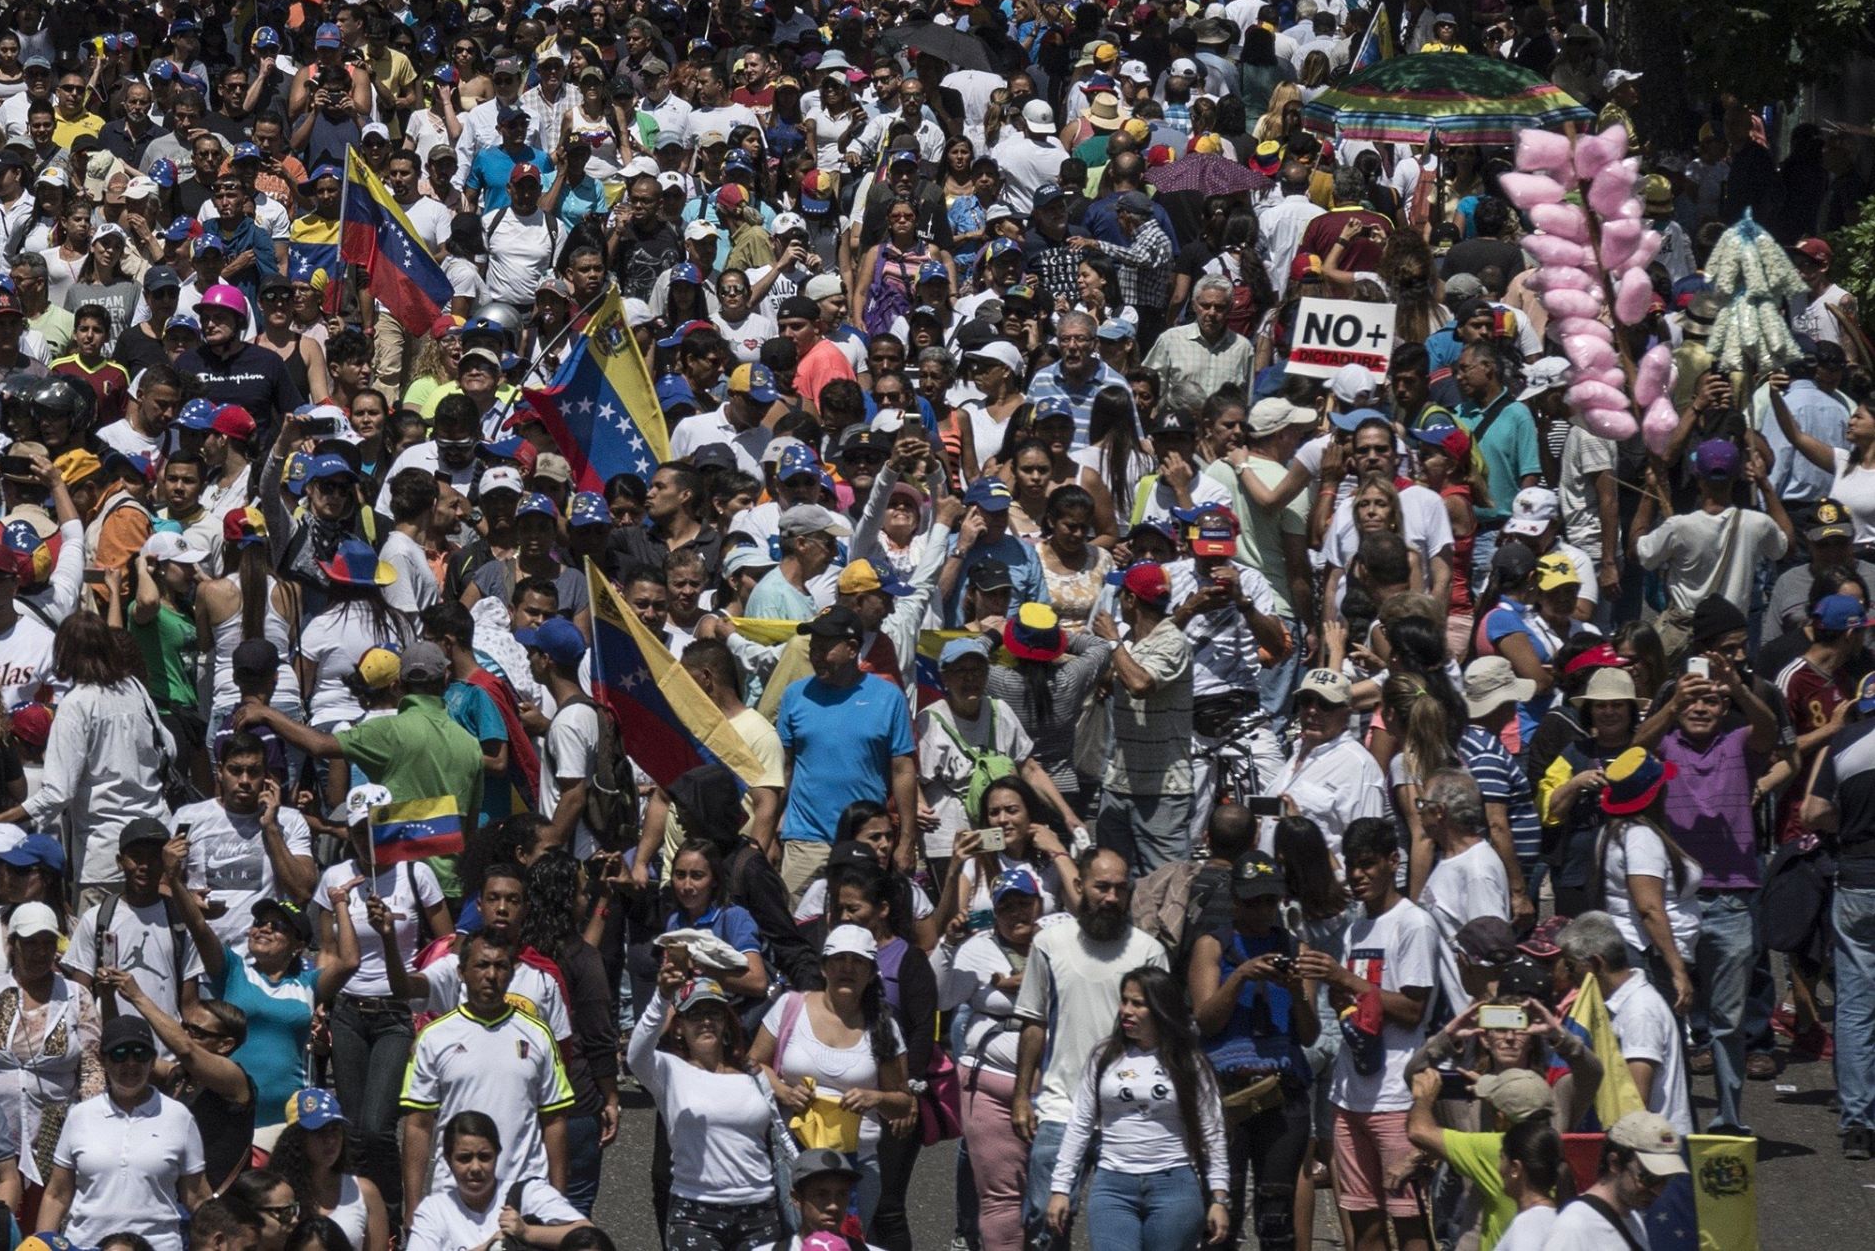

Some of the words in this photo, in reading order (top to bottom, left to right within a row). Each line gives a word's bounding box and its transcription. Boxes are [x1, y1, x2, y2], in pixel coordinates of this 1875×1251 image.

[1299, 349, 1381, 368] DICTADURA
[197, 372, 265, 385] Champion
[1809, 700, 1827, 728] 8
[215, 870, 250, 880] AIR
